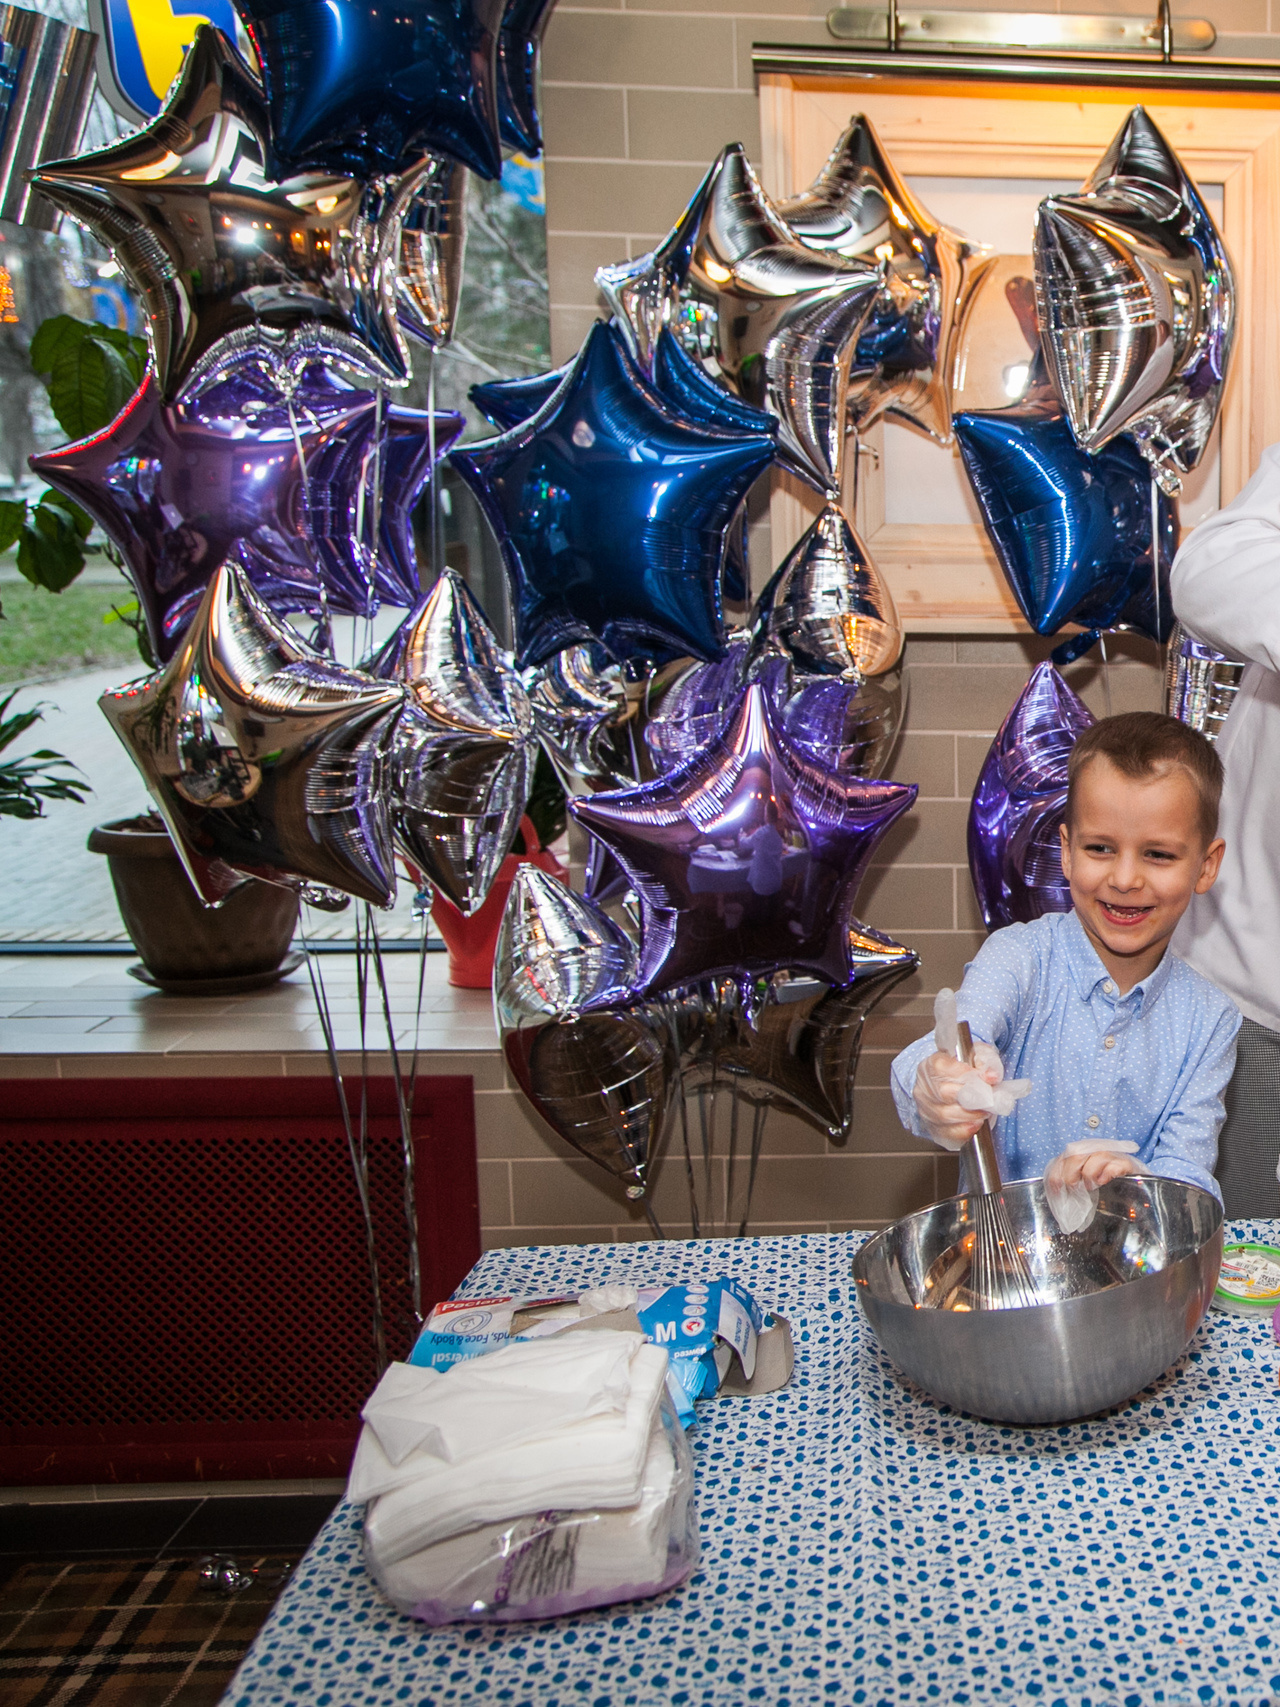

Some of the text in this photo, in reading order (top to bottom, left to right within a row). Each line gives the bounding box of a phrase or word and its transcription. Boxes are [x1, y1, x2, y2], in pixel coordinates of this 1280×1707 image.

[441, 1298, 504, 1312] Paclan
[655, 1320, 677, 1343] M
[430, 1334, 455, 1347] Body
[456, 1335, 464, 1346] &
[465, 1334, 489, 1344] Face
